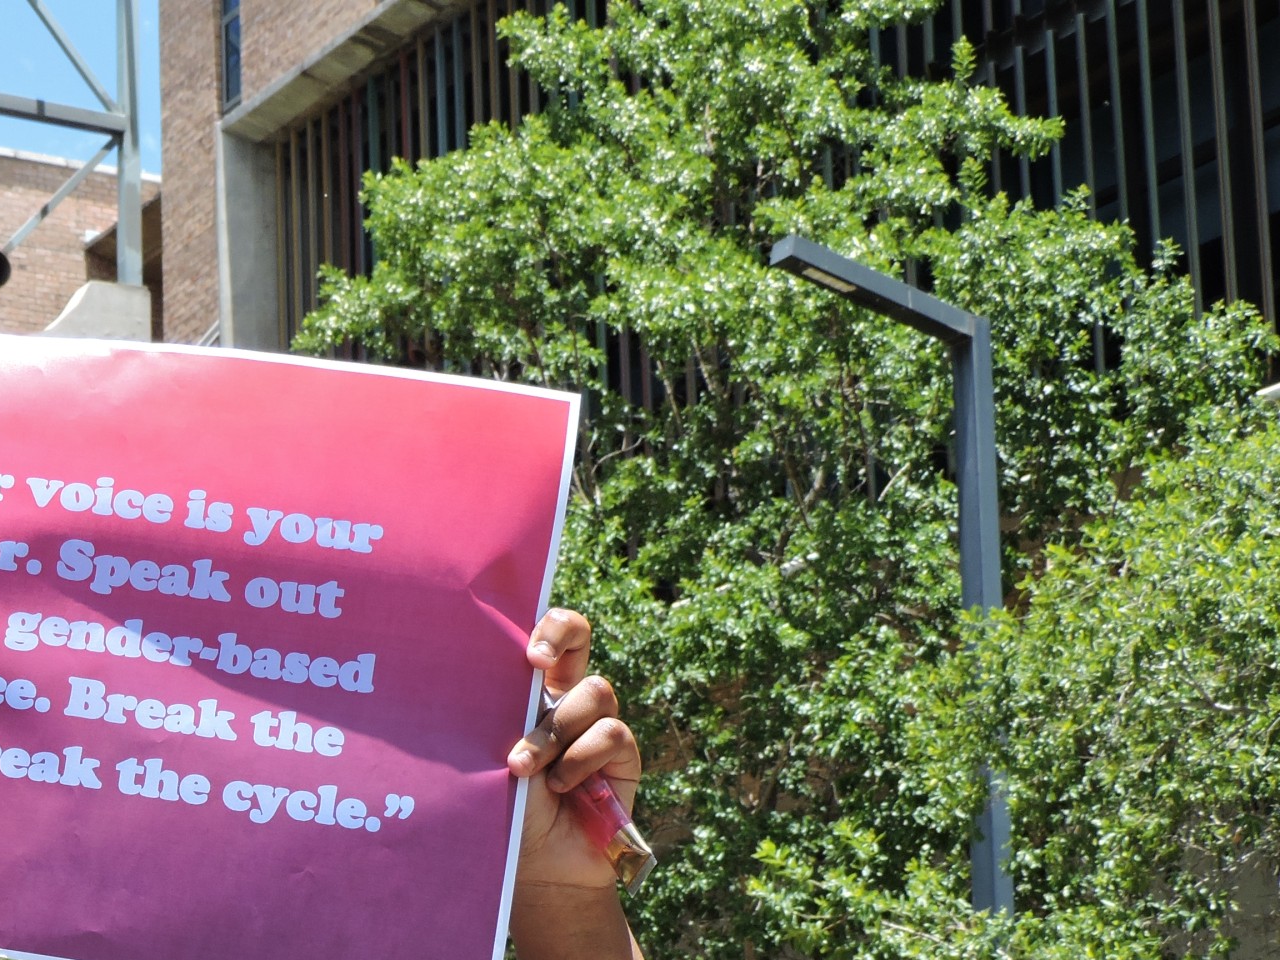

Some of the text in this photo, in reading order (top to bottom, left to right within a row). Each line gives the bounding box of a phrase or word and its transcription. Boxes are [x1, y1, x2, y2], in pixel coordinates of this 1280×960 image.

[27, 478, 172, 522] voice
[185, 491, 232, 531] is
[245, 508, 382, 552] your
[58, 541, 230, 601] Speak
[246, 578, 343, 617] out
[5, 613, 375, 692] gender-based
[65, 677, 236, 740] Break
[251, 712, 344, 756] the
[117, 759, 209, 804] the
[224, 782, 414, 831] cycle.”
